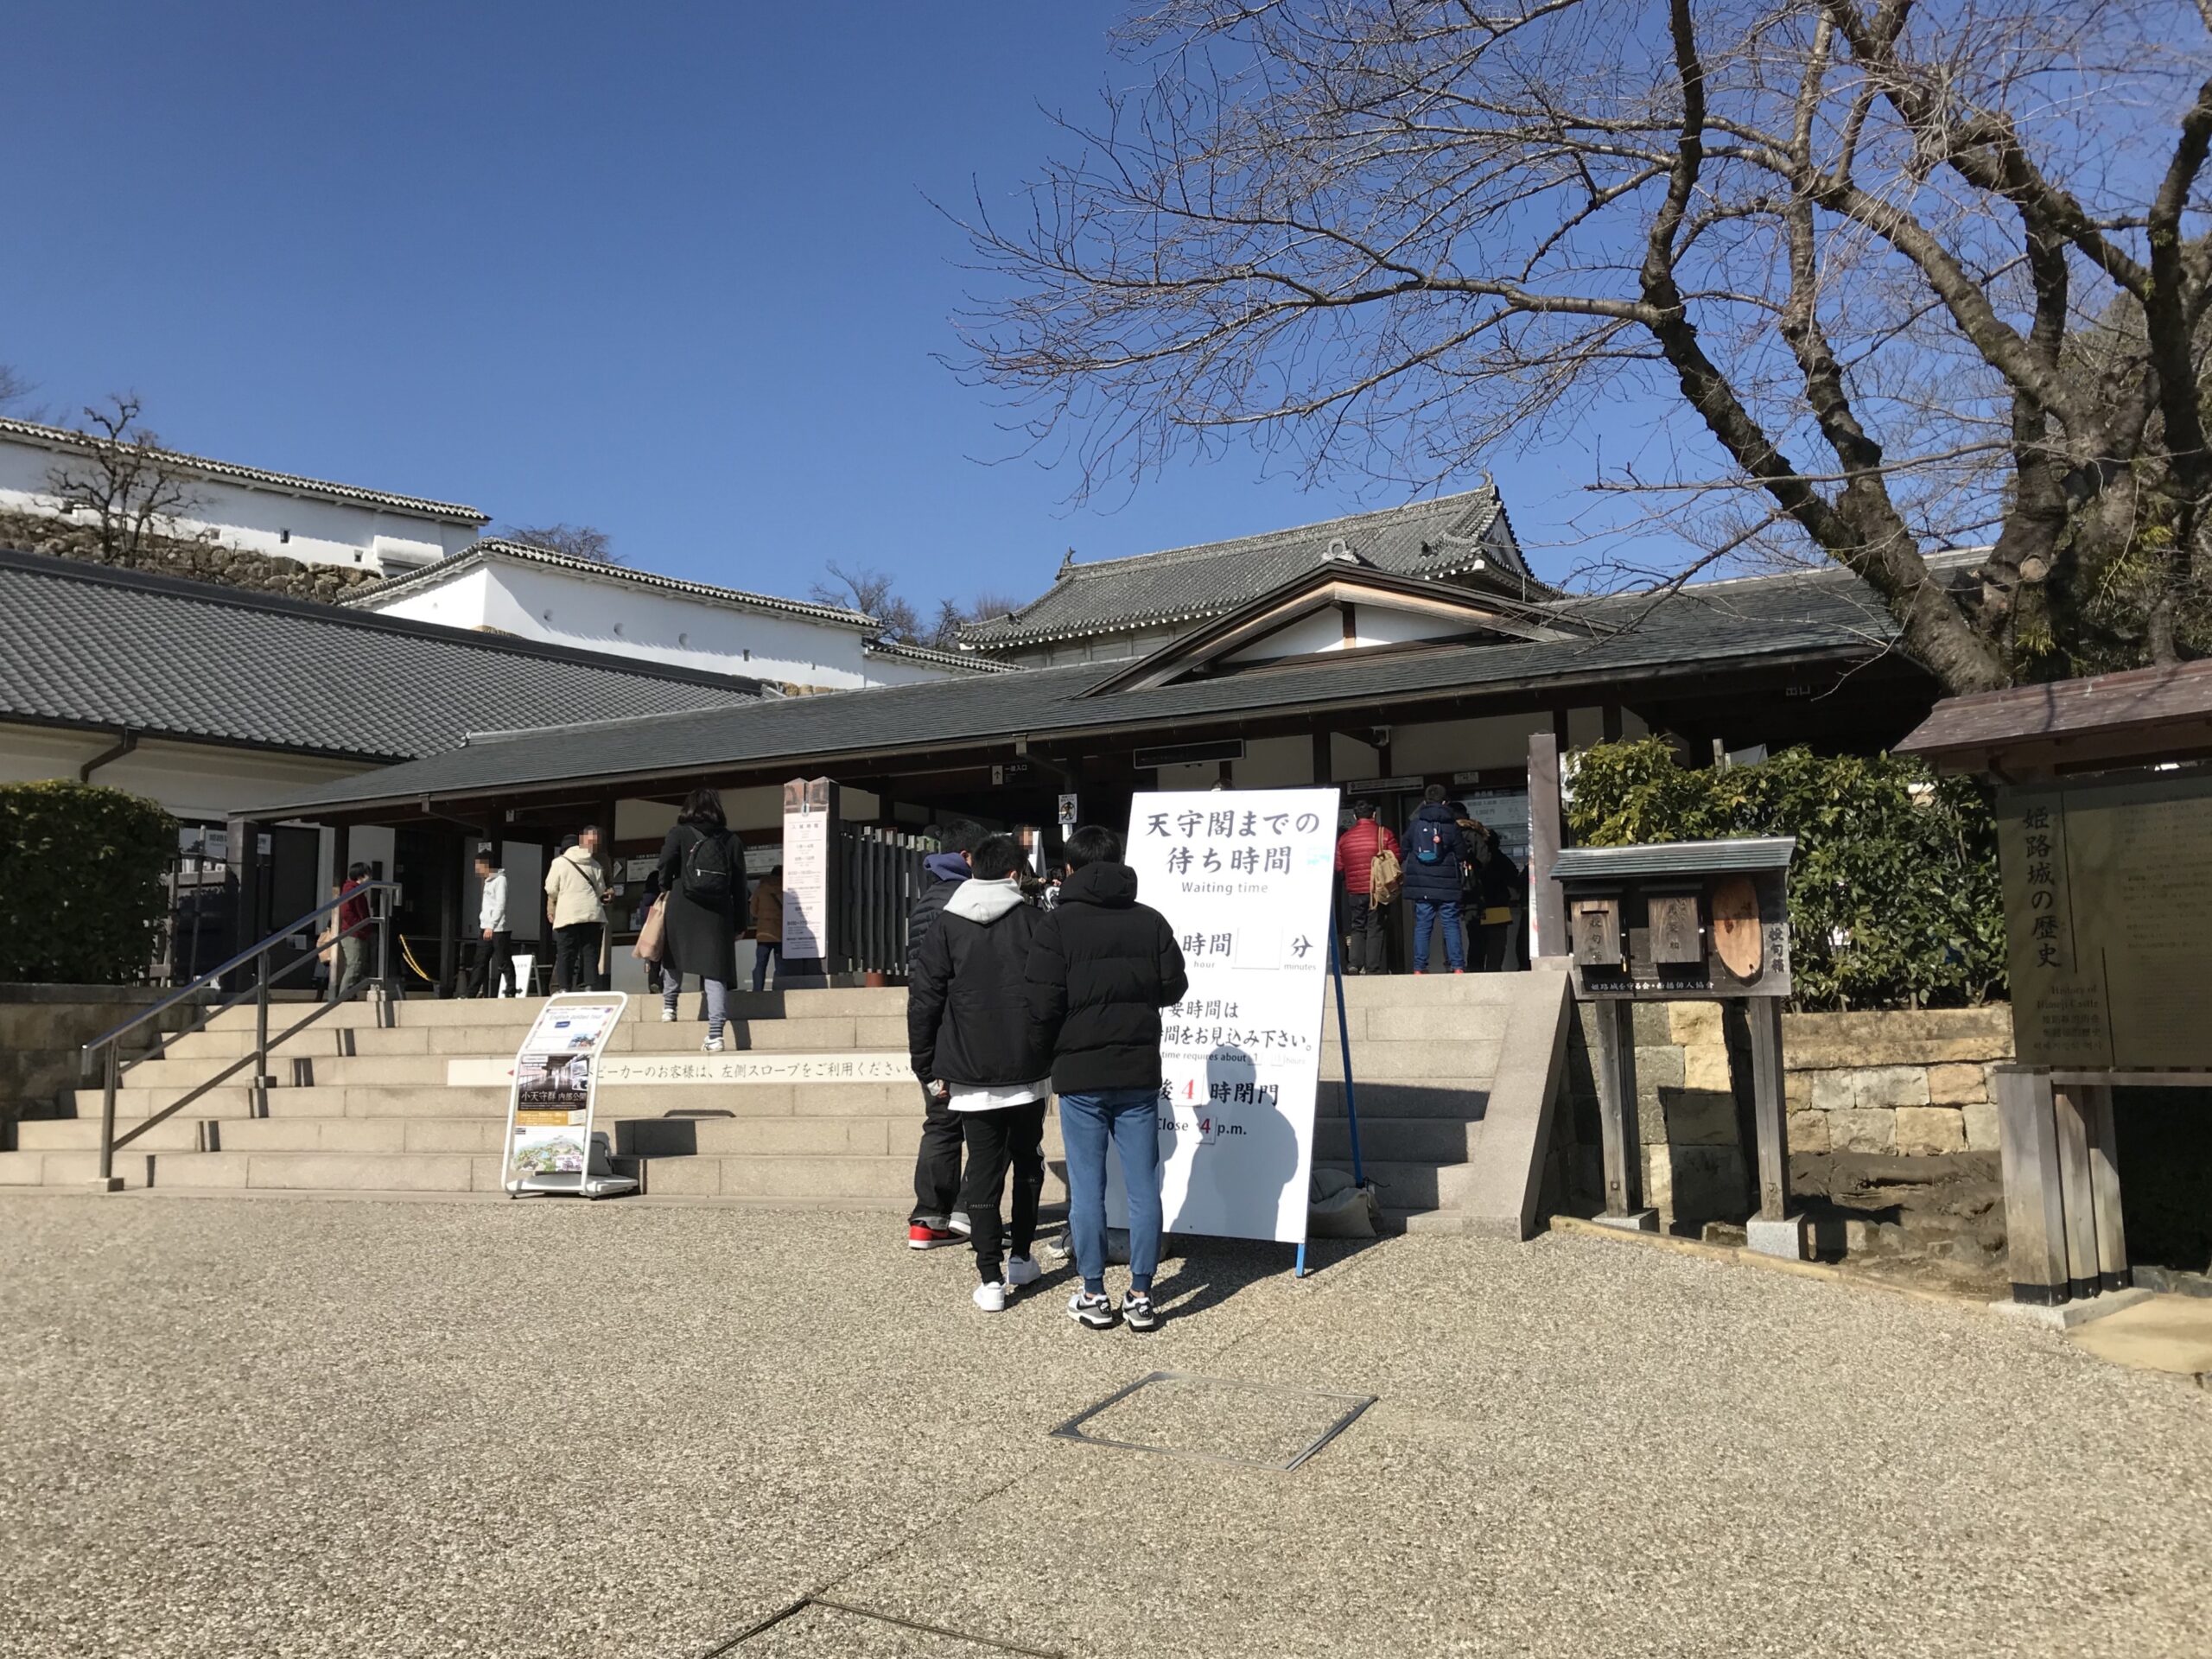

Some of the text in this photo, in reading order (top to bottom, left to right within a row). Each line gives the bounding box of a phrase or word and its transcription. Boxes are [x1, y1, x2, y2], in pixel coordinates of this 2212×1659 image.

[1146, 810, 1319, 838] 天守閣までの
[1166, 846, 1292, 875] 待ち時間
[1182, 881, 1268, 895] Waiting time
[2022, 806, 2062, 969] 姫路城の歴史
[1182, 932, 1313, 958] 時間 分
[1193, 960, 1317, 971] hour minutes
[1160, 1000, 1239, 1020] 要時間は
[1160, 1025, 1312, 1052] 間をお見込み下さい。
[1161, 1051, 1181, 1060] time
[1183, 1052, 1218, 1063] requires
[1221, 1052, 1247, 1063] about
[521, 1090, 556, 1102] 小天守群
[1199, 1118, 1211, 1135] 4
[1217, 1123, 1248, 1138] p.m.
